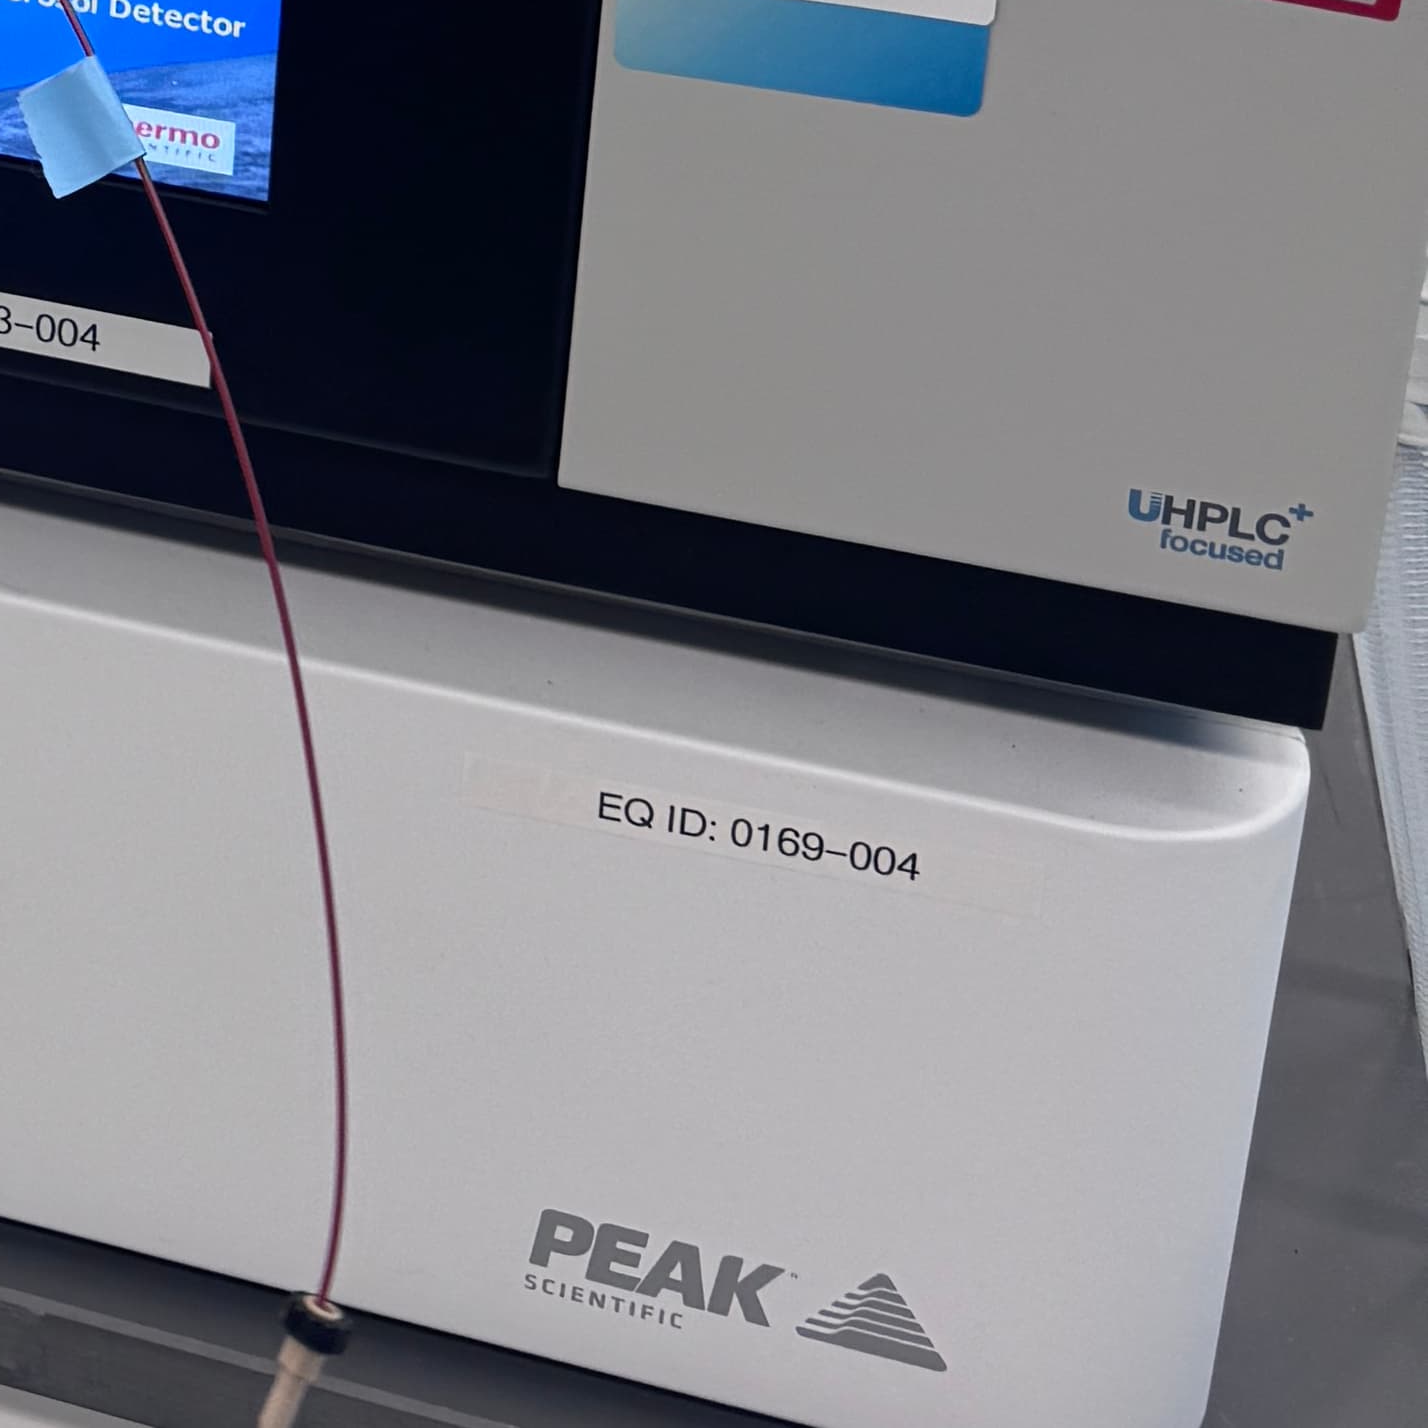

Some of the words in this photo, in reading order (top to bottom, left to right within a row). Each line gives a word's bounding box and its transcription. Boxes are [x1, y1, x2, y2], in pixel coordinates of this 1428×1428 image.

[135, 120, 221, 150] ermo
[1160, 528, 1286, 571] focused
[598, 790, 655, 830] EQ
[667, 804, 718, 842] ID:
[730, 817, 922, 882] 0169-004
[524, 1272, 685, 1330] SCIENTIFIC
